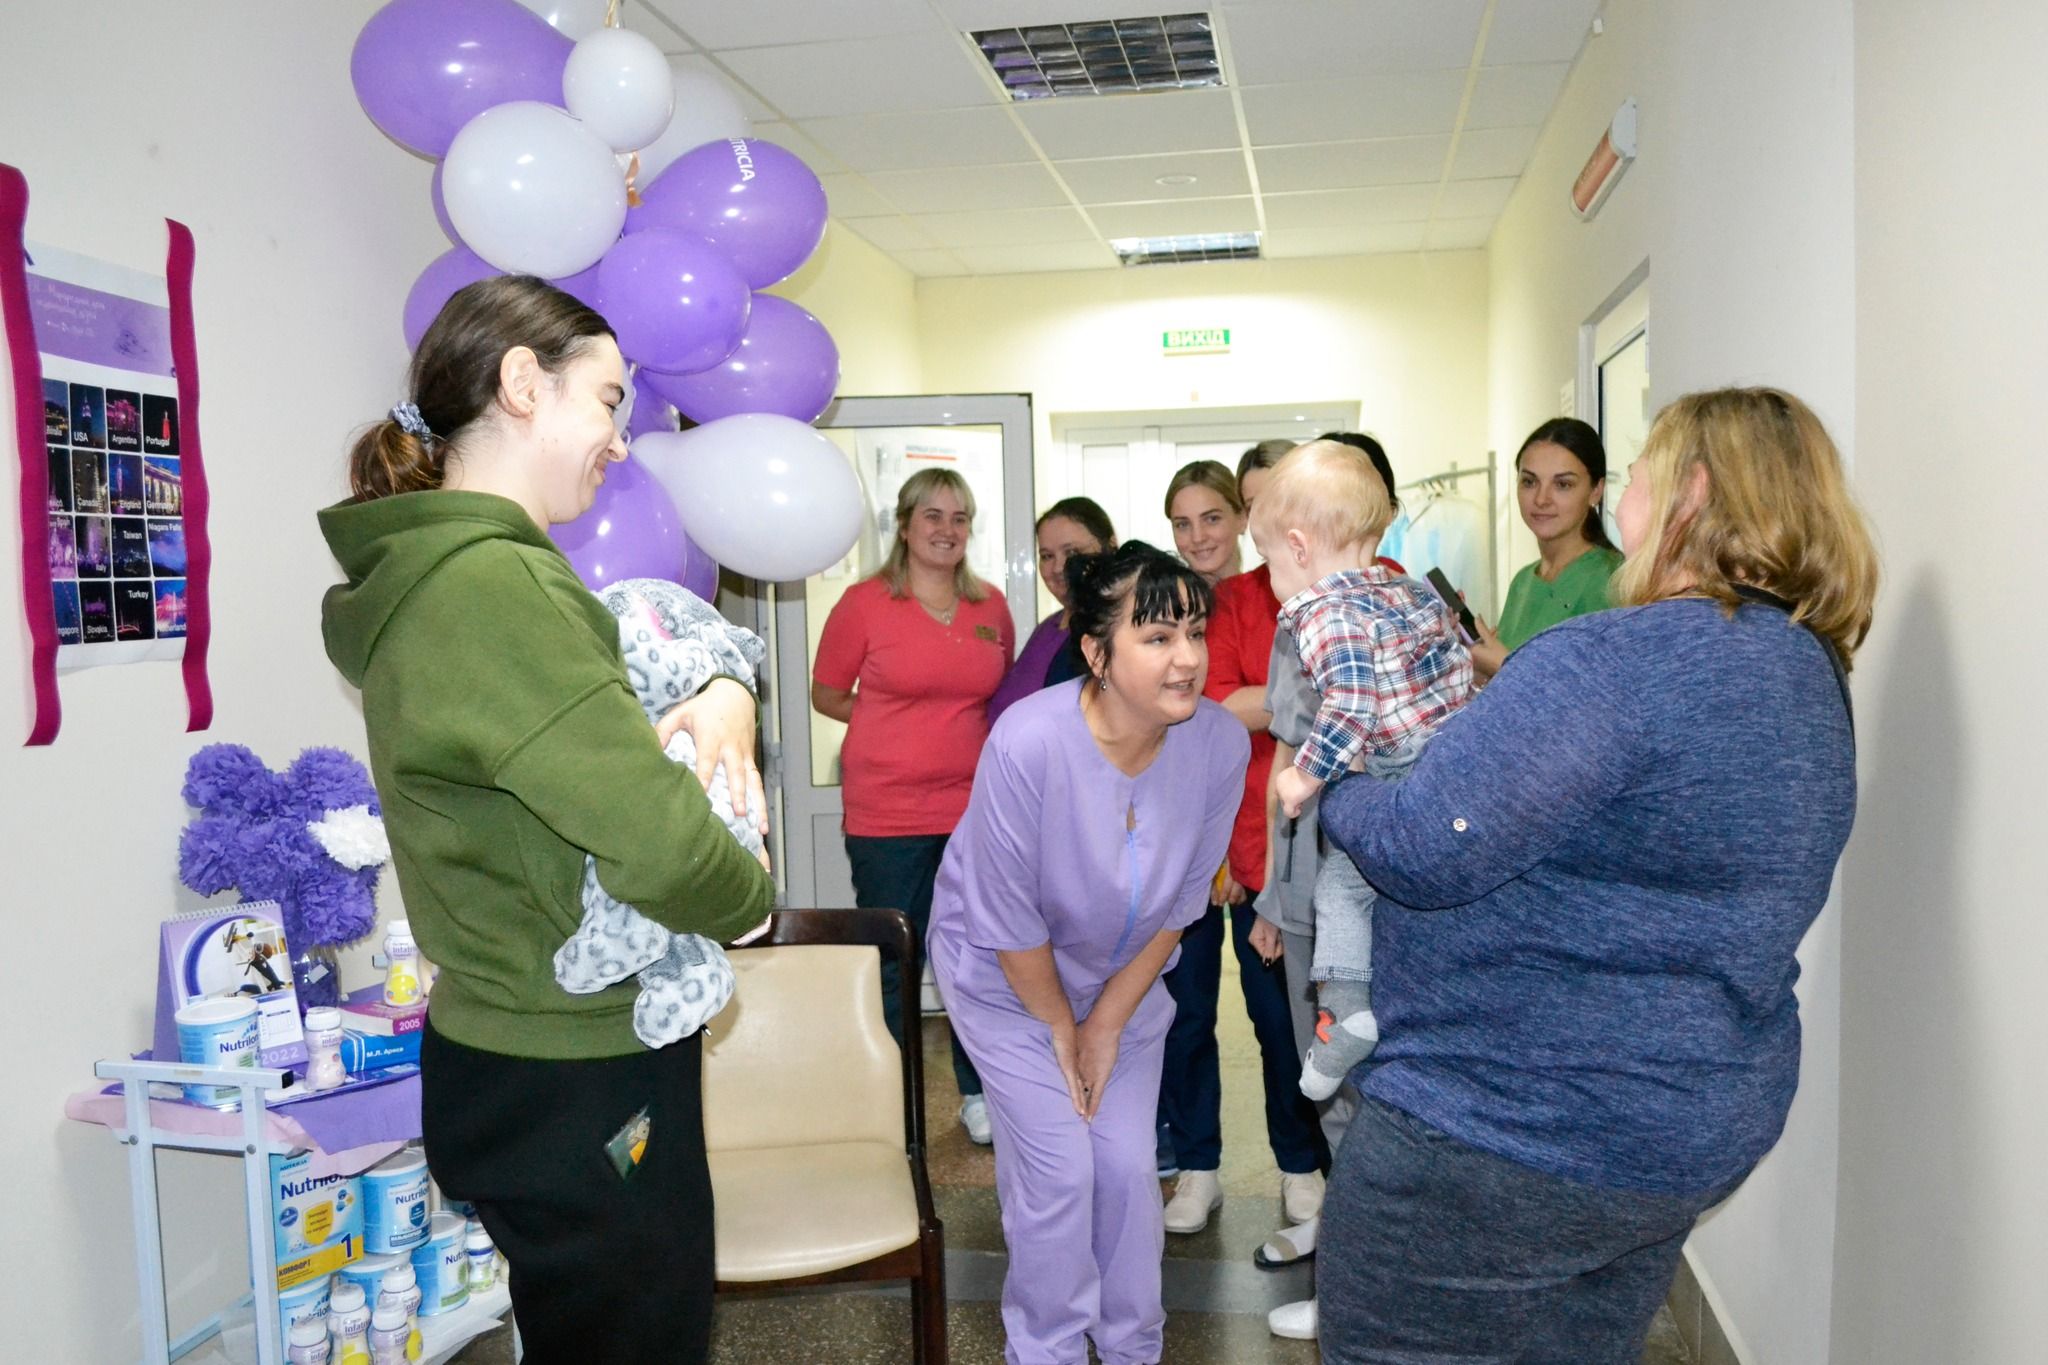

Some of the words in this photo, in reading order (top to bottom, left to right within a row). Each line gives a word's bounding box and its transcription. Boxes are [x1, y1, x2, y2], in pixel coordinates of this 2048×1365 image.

[73, 431, 89, 443] USA
[112, 433, 138, 446] Argentina
[145, 435, 171, 448] Portugal
[148, 522, 169, 533] Niagara
[122, 530, 143, 540] Taiwan
[127, 589, 149, 600] Turkey
[399, 1018, 421, 1032] 2005
[261, 1046, 299, 1065] 2022
[340, 1232, 353, 1259] 1
